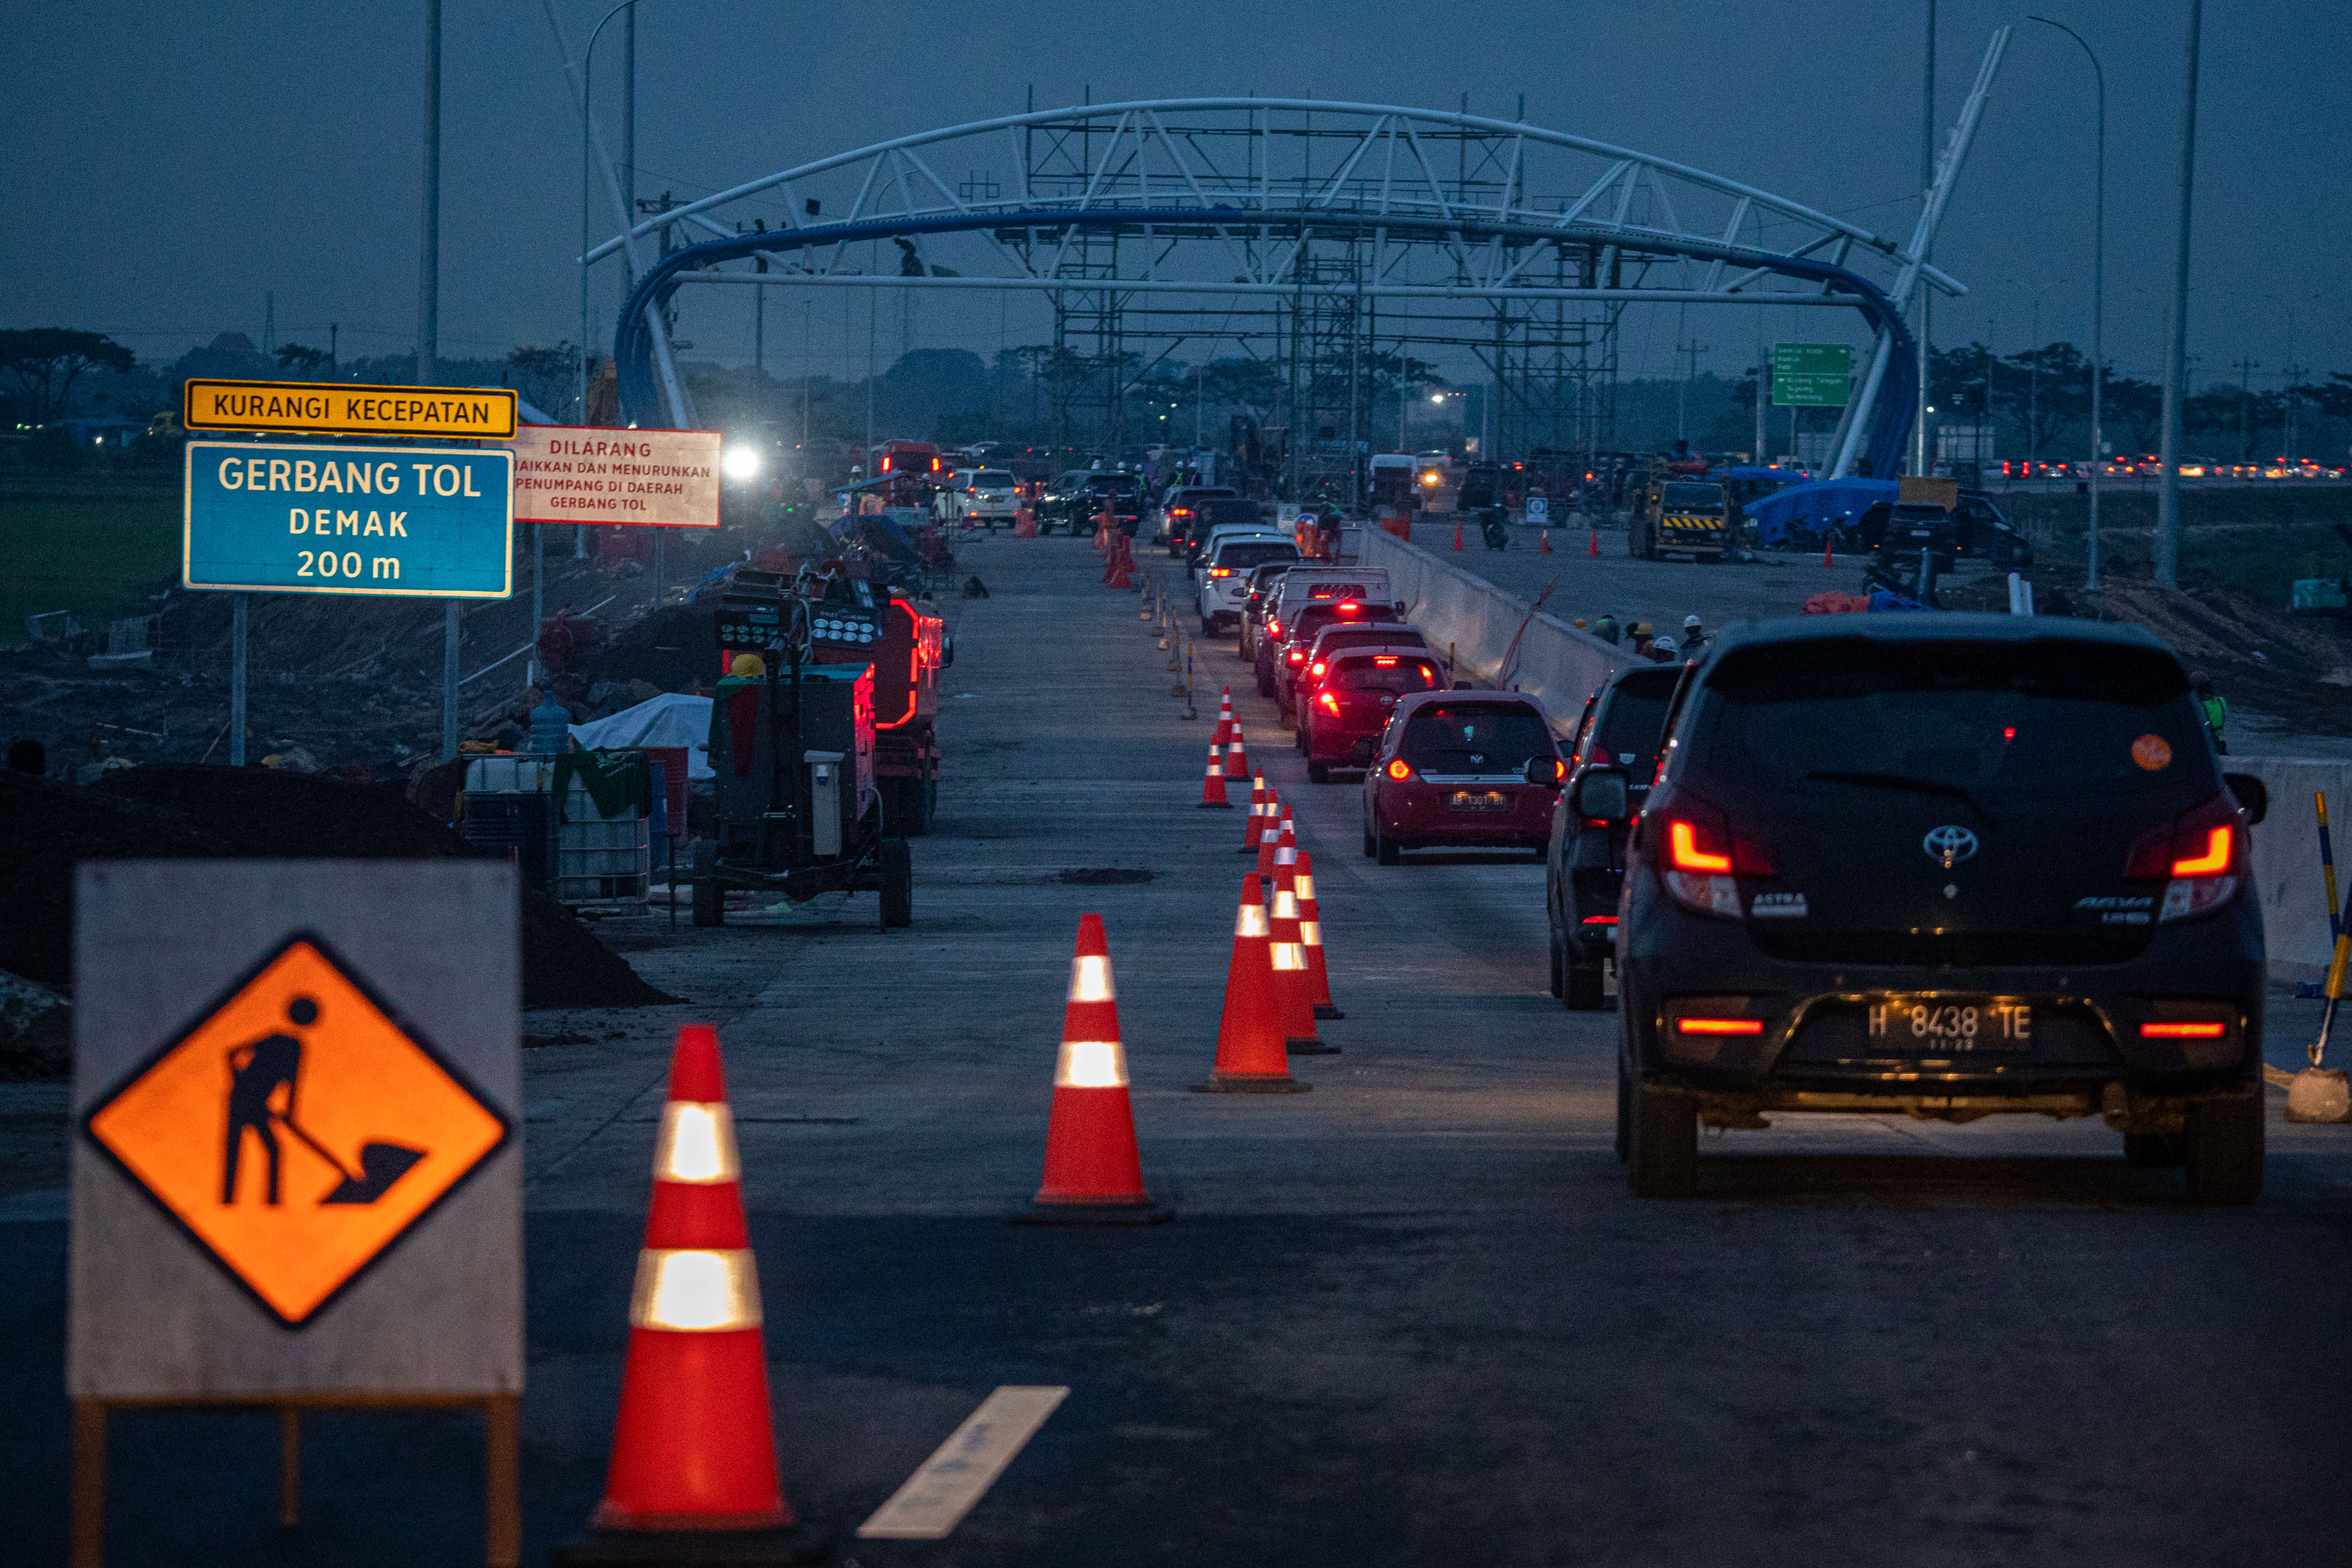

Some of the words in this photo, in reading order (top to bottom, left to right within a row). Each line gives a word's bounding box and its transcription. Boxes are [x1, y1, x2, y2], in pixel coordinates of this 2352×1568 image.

[214, 394, 329, 419] KURANGI
[346, 399, 489, 424] KECEPATAN
[550, 440, 651, 457] DILARANG
[219, 457, 400, 494] GERBANG
[412, 464, 482, 497] TOL
[577, 462, 607, 474] DAN
[612, 464, 710, 478] MENURUNKAN
[516, 478, 603, 492] PENUMPANG
[628, 482, 683, 494] DAERAH
[550, 496, 617, 509] GERBANG
[622, 499, 647, 511] TOL
[289, 508, 408, 537] DEMAK
[297, 550, 362, 578] 200
[372, 557, 400, 579] m
[1869, 1005, 1887, 1037] H
[1911, 1005, 1978, 1038] 8438
[1999, 1005, 2031, 1039] TE
